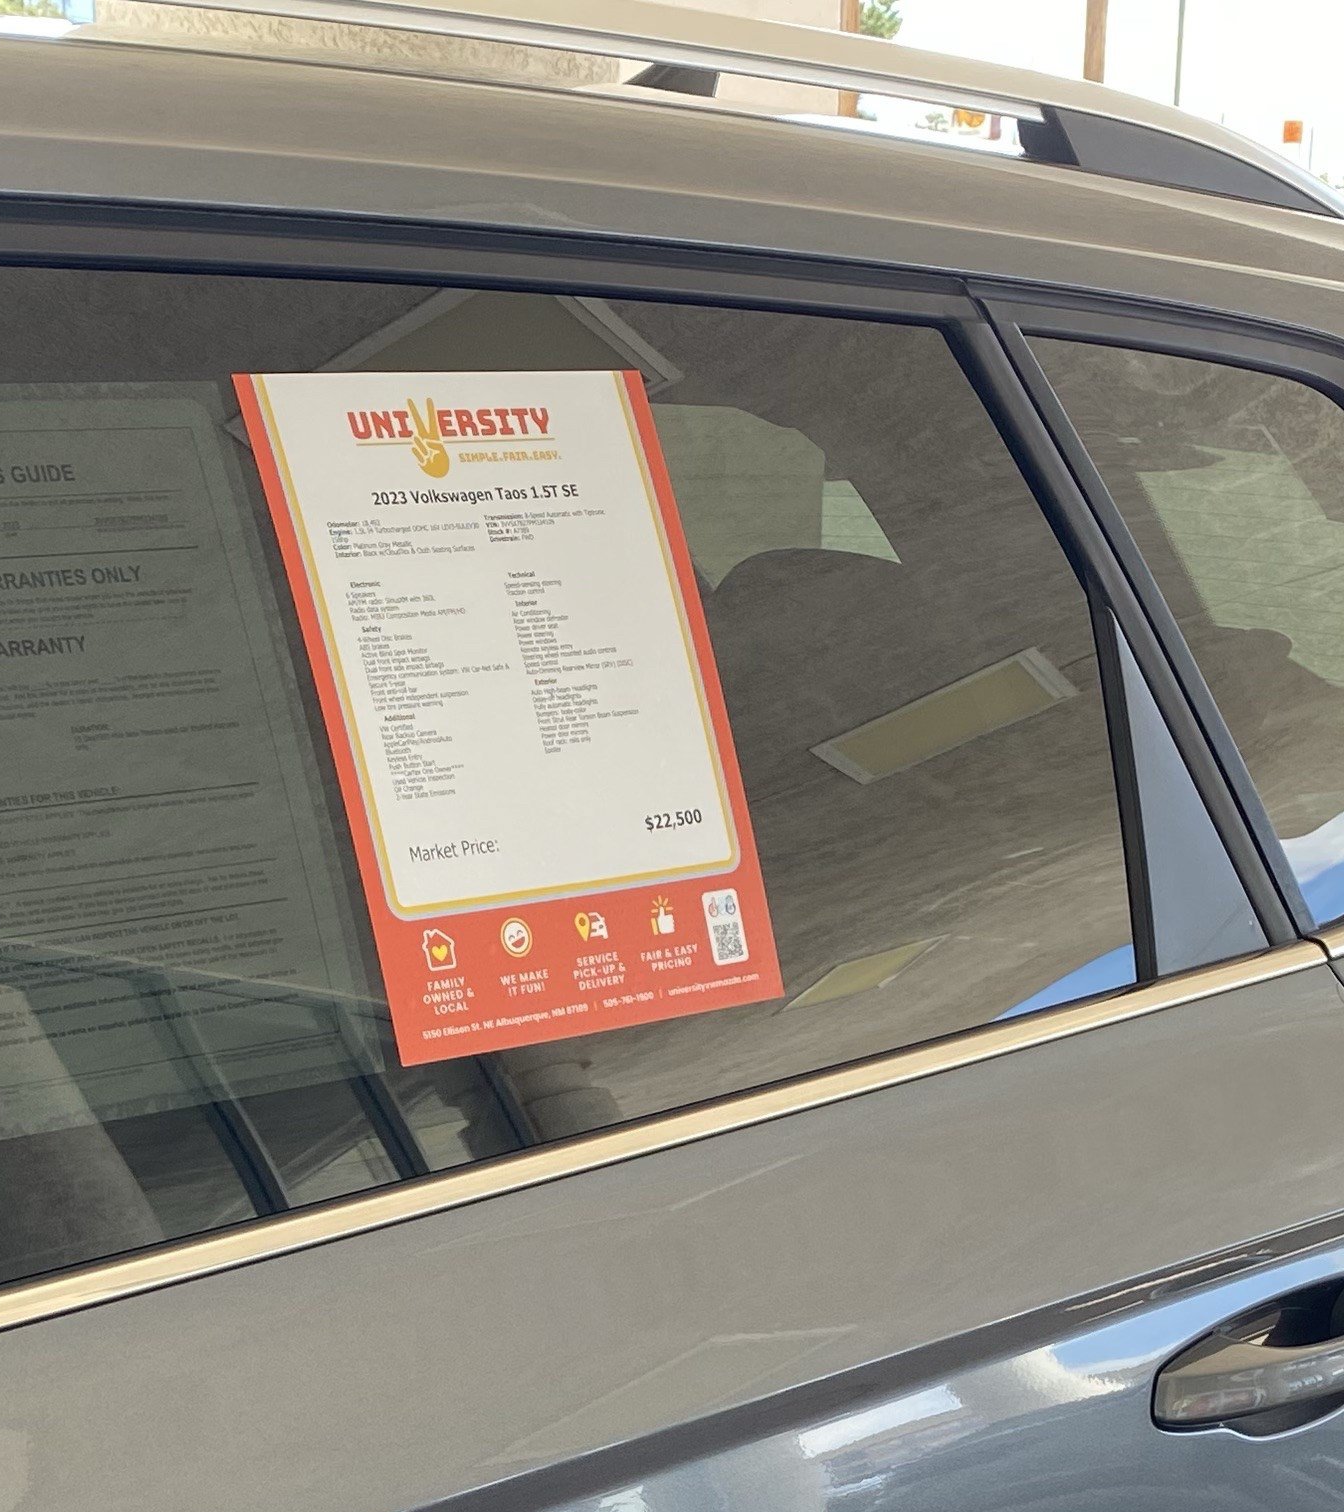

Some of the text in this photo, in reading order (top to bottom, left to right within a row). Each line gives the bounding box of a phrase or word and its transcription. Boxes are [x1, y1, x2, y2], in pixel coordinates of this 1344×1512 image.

[347, 397, 549, 440] UNIVERSITY
[10, 463, 76, 484] GUIDE
[370, 484, 579, 507] 2023 Volkswagen Taos 1.5T SE
[90, 565, 143, 587] ONLY
[508, 570, 535, 578] Technical
[349, 580, 381, 589] Electronic
[361, 625, 382, 633] Safety
[383, 713, 415, 722] Additional
[408, 807, 703, 863] Market Price: $22,500
[575, 951, 619, 968] SERVICE
[639, 943, 699, 962] FAIR & EASY
[572, 961, 626, 980] PICK-UP &
[650, 955, 693, 972] PRICING
[425, 975, 466, 992] FAMILY
[498, 968, 549, 986] WE MAKE
[578, 973, 626, 991] DELIVERY
[421, 986, 475, 1006] OWNED &
[507, 981, 546, 997] IT FUN!
[433, 999, 469, 1016] LOCAL
[422, 1028, 442, 1040] 5150
[442, 1023, 471, 1037] Ellison
[470, 1021, 482, 1032] St.
[481, 1019, 494, 1029] NE
[494, 1008, 551, 1028] Albuquerque,
[550, 1006, 565, 1017] NM
